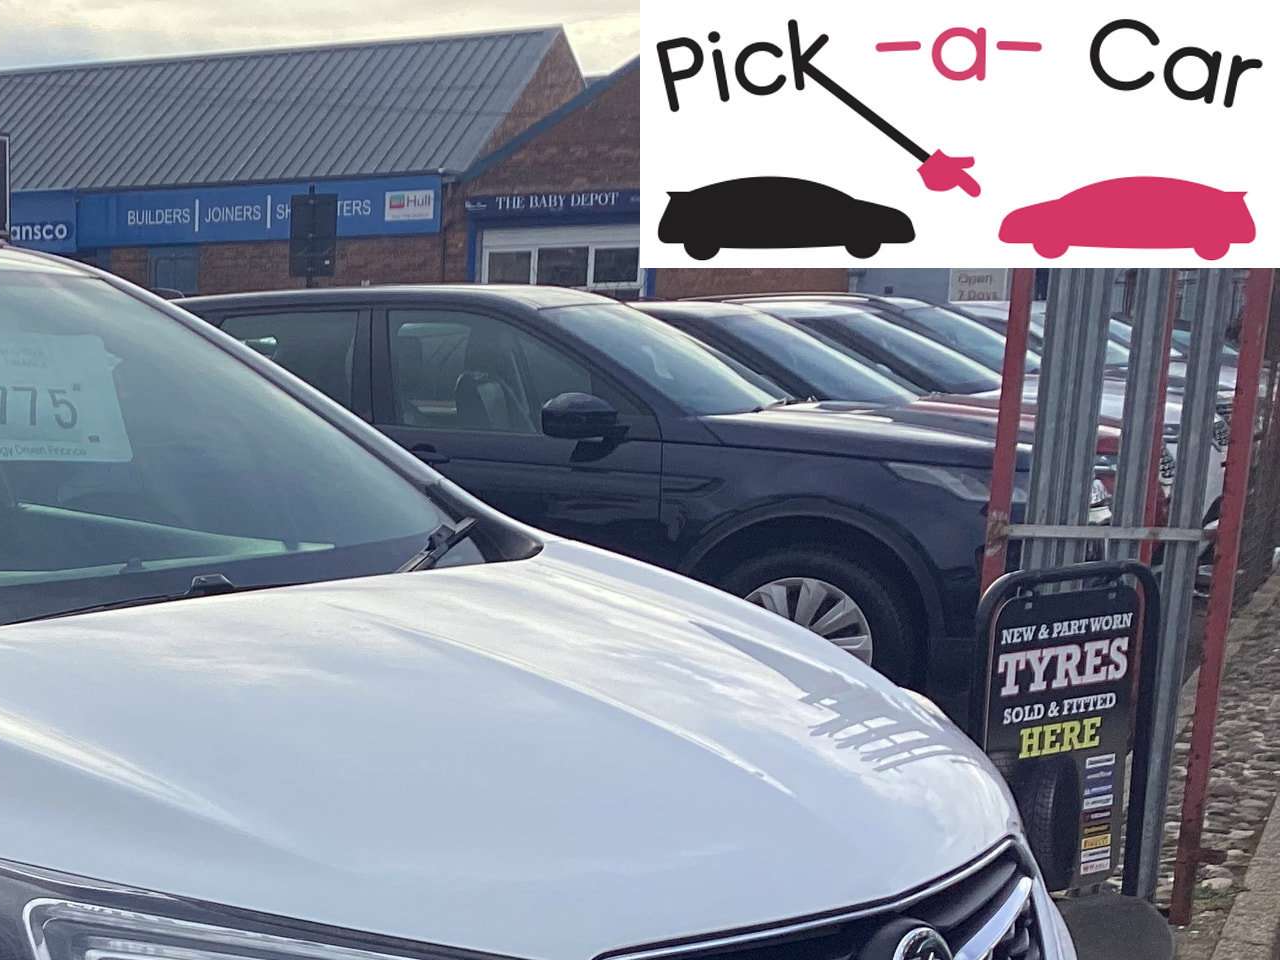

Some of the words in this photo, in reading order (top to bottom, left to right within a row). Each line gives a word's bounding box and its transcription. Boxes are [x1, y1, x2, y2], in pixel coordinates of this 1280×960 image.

[127, 208, 191, 225] BUILDERS
[205, 205, 262, 223] JOINERS
[496, 195, 526, 210] THE
[529, 194, 567, 209] BABY
[571, 191, 619, 207] DEPOT
[11, 224, 67, 240] ansco
[1001, 625, 1036, 645] NEW
[1038, 624, 1050, 640] &
[1052, 618, 1089, 638] PART
[1090, 613, 1134, 632] WORN
[998, 636, 1129, 697] TYRES
[1003, 703, 1045, 725] SOLD
[1048, 701, 1060, 717] &
[1062, 692, 1117, 716] FITTED
[1019, 716, 1102, 760] HERE
